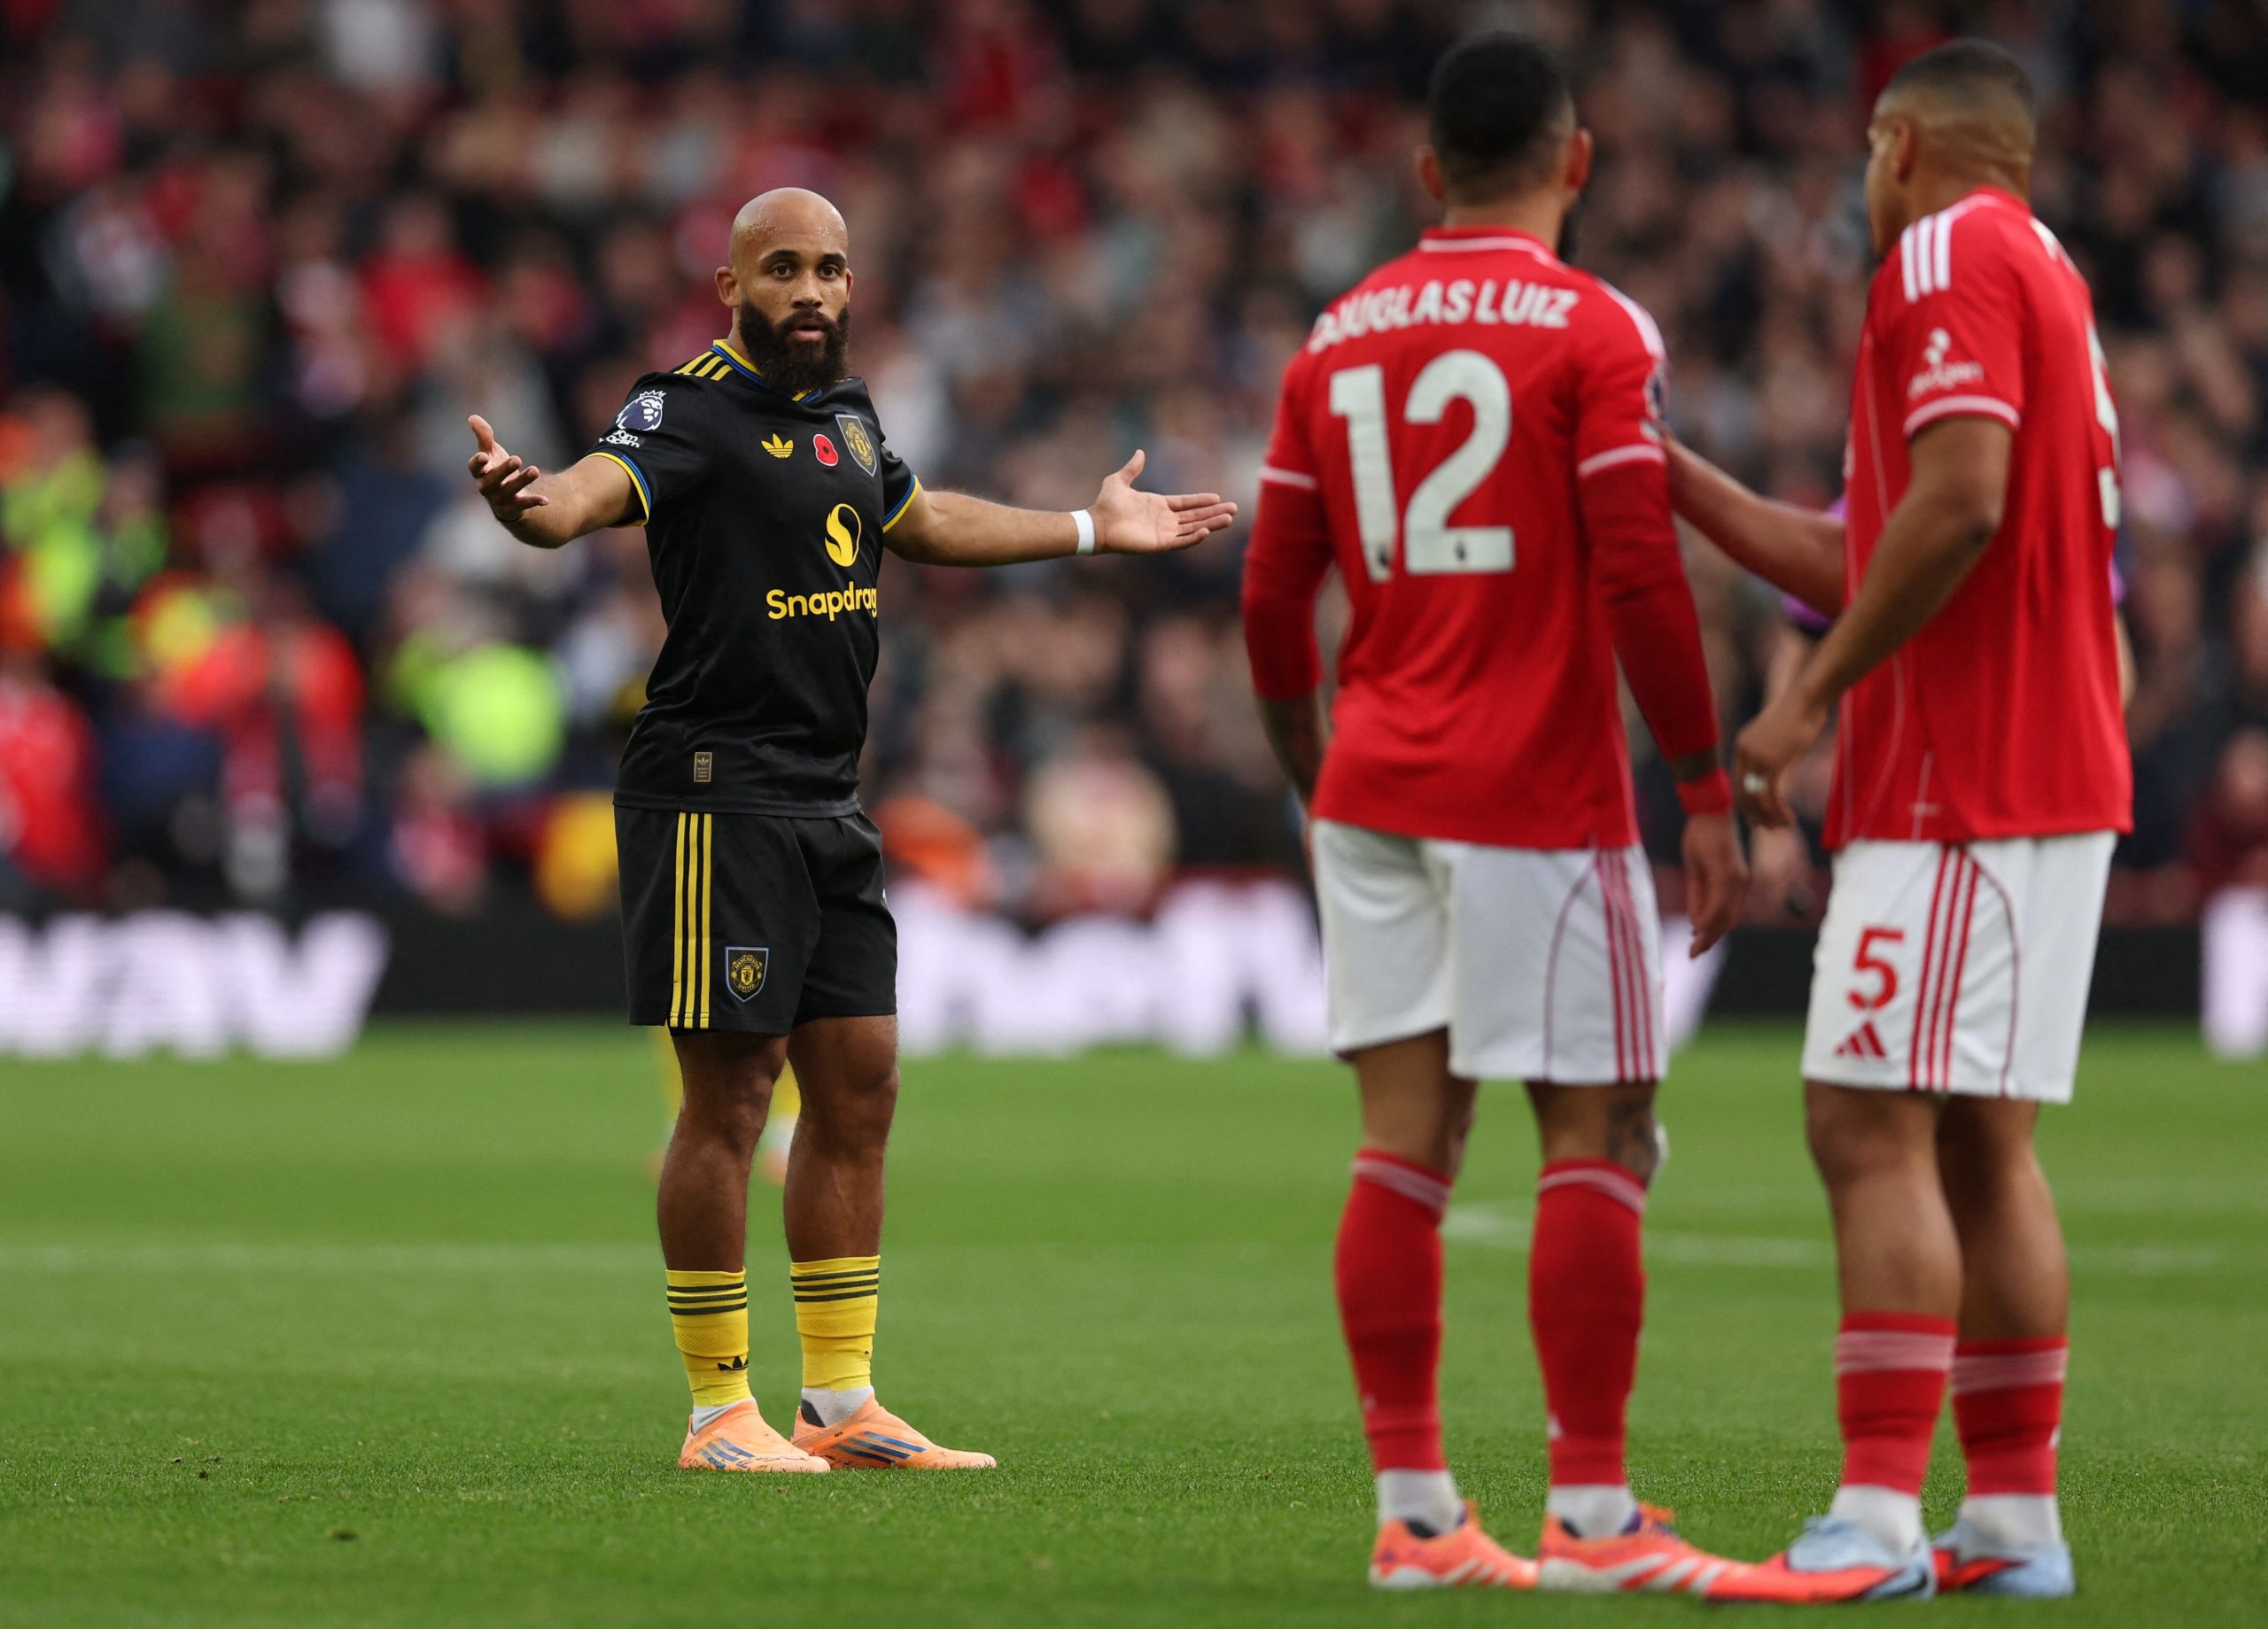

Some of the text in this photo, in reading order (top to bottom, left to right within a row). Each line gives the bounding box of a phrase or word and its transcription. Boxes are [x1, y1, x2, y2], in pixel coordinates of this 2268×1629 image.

[1474, 278, 1579, 329] LUIZ
[1331, 348, 1515, 583] 12
[766, 581, 877, 621] Snapdrag
[1846, 925, 1906, 1011] 5
